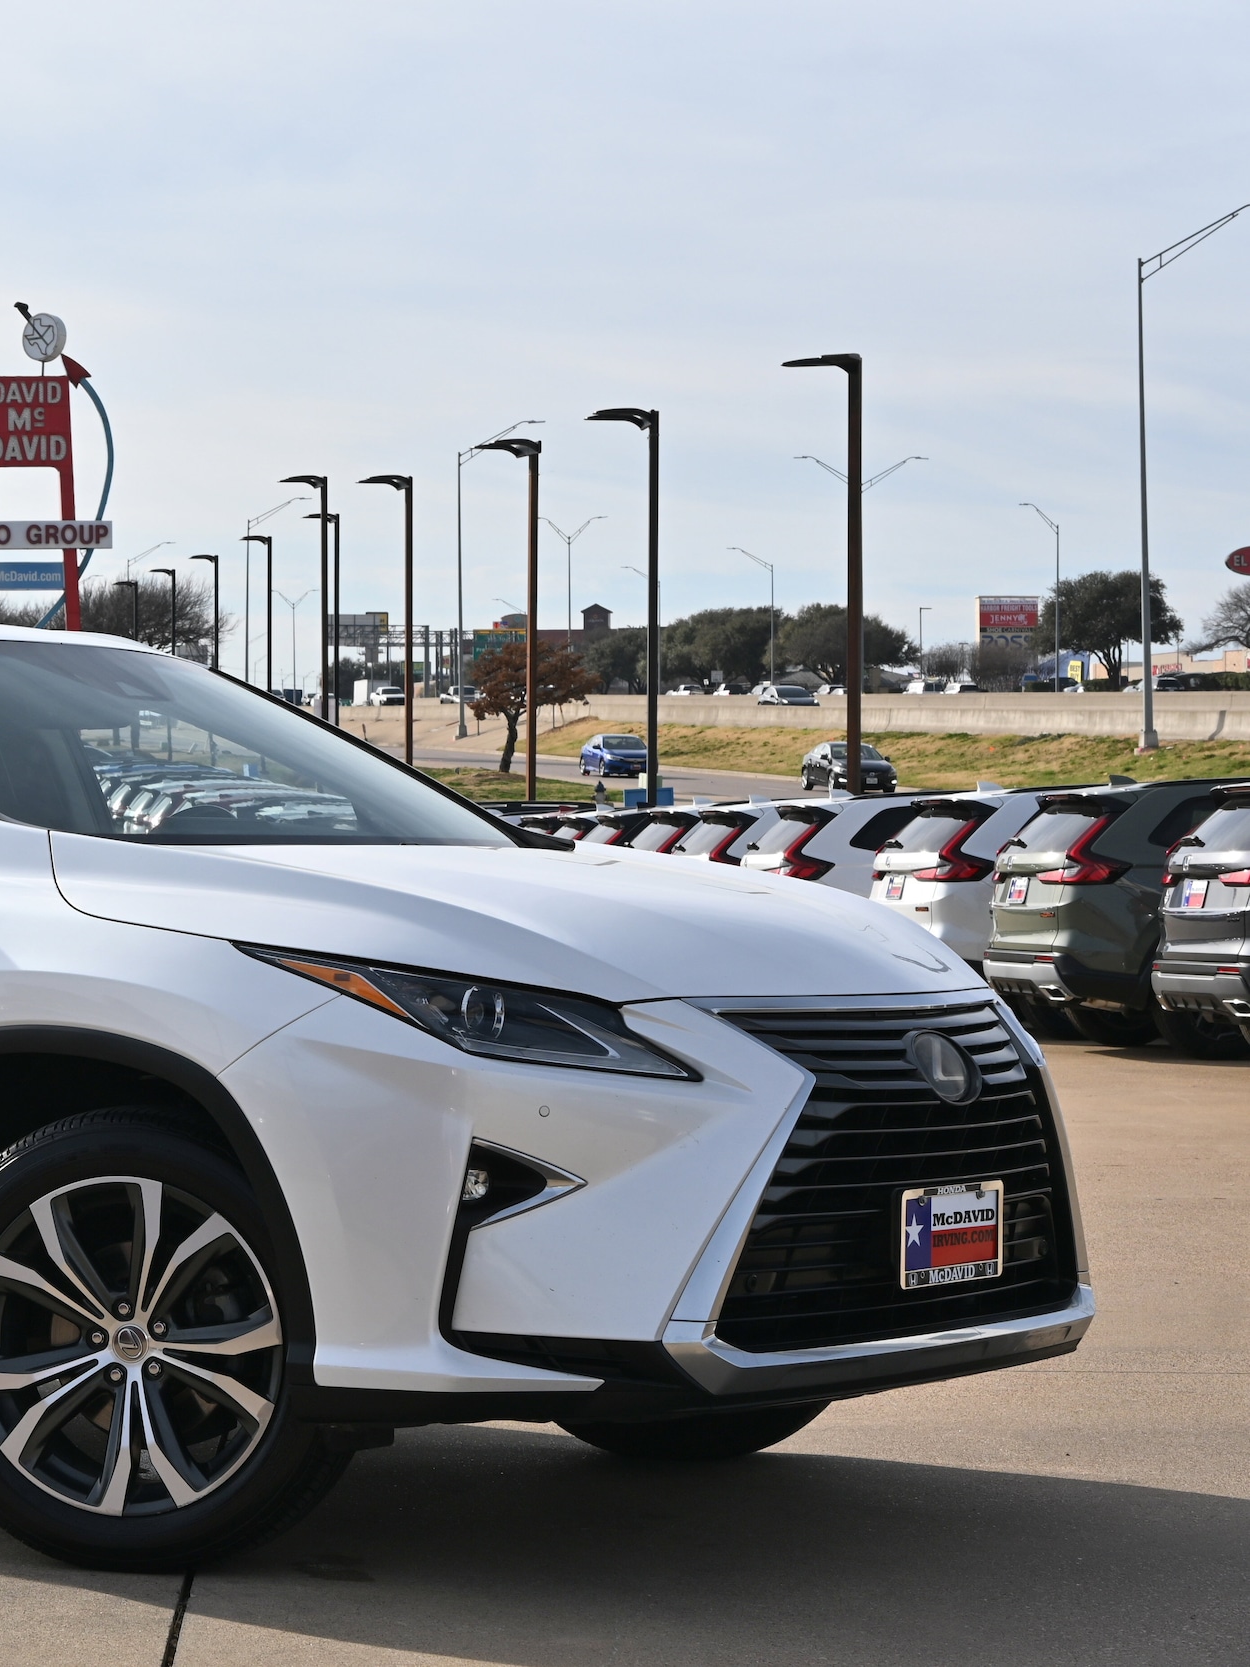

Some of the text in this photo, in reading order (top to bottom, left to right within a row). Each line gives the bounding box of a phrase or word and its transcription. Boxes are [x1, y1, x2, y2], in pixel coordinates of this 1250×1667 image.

[26, 524, 109, 545] GROUP
[1001, 604, 1021, 612] FREIGHT
[1022, 604, 1037, 612] TOOLS
[990, 614, 1019, 624] JENNY
[937, 1185, 967, 1195] HONDA
[932, 1208, 995, 1227] McDAVID
[932, 1229, 996, 1248] IRVING.COM
[928, 1264, 976, 1284] McDAVID
